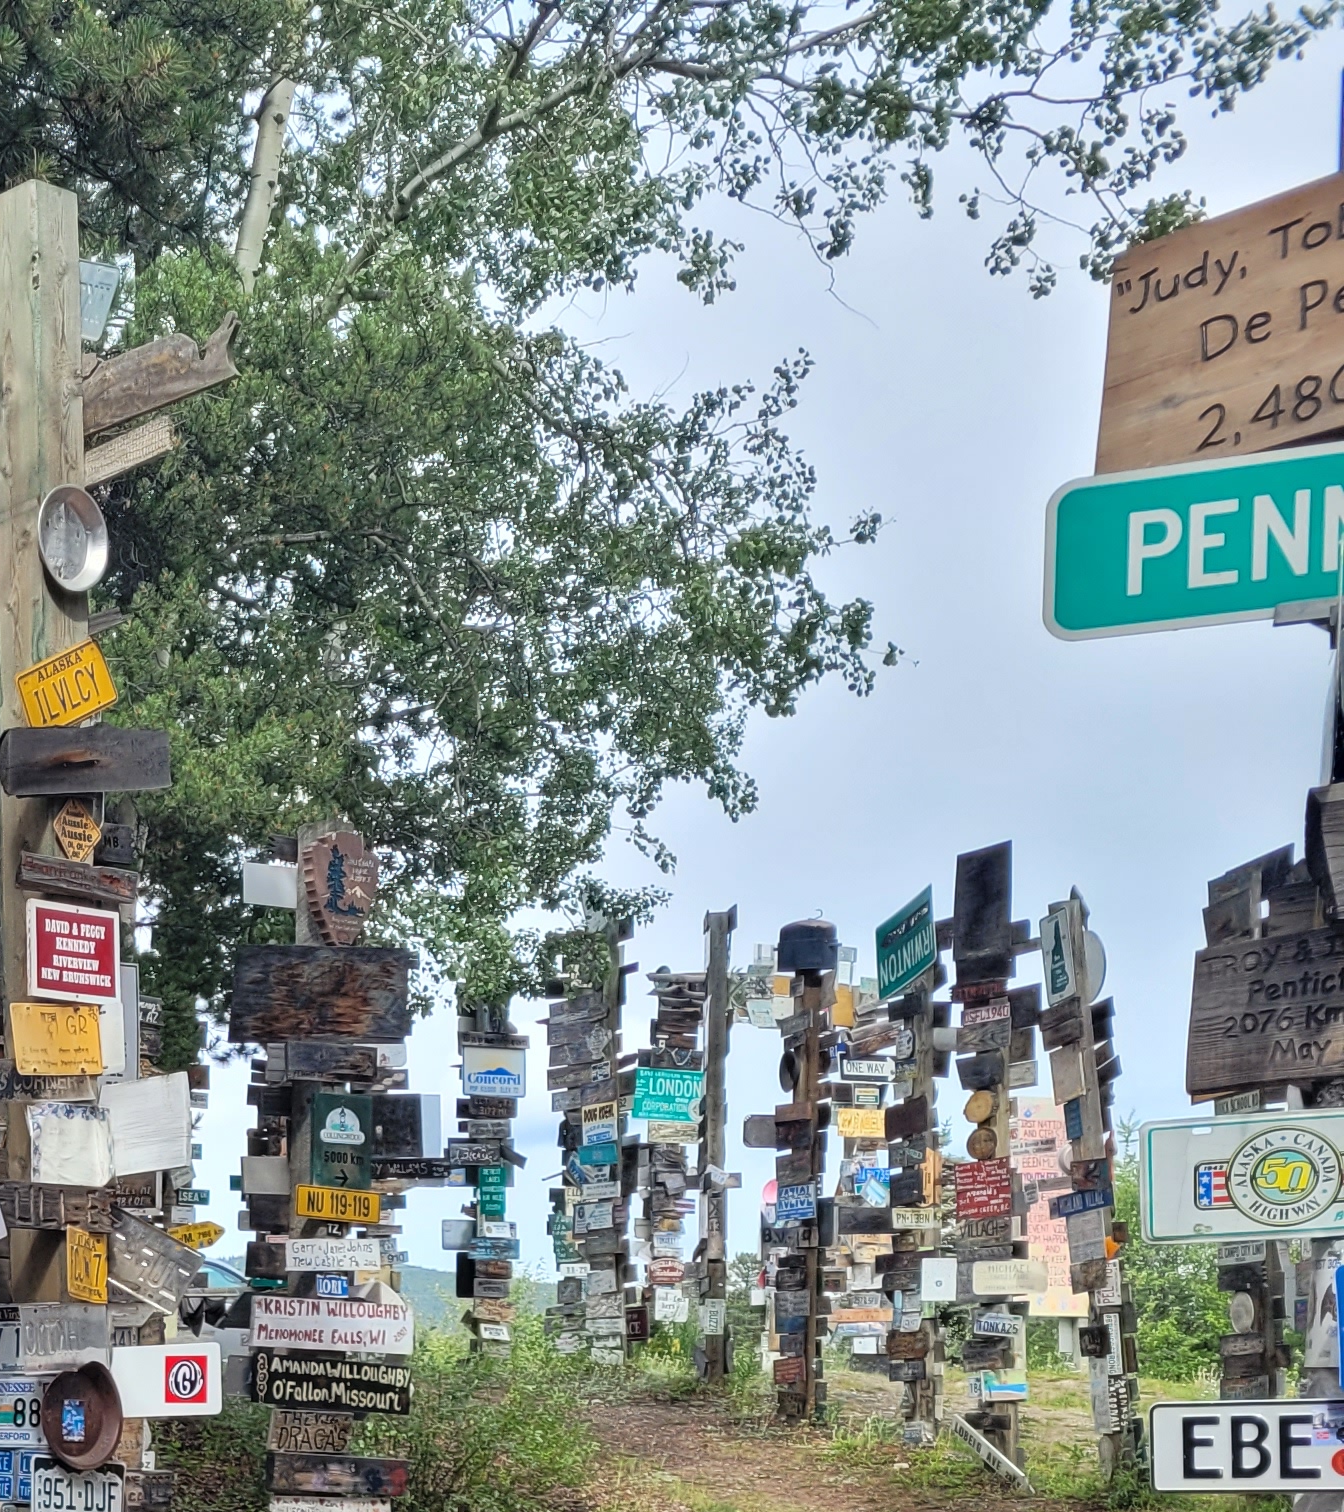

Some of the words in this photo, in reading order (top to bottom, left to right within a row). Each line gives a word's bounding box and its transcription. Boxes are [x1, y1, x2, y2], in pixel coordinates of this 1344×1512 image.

[1200, 312, 1272, 362] De
[45, 919, 66, 933] DAVID
[80, 923, 105, 939] PEGGY
[56, 937, 96, 953] KENNEDY
[54, 955, 100, 971] RIVERVIEW
[880, 924, 934, 985] IRWINTON
[63, 970, 111, 988] BRUNSWICK
[846, 1062, 863, 1074] ONE
[865, 1062, 885, 1074] WAY
[467, 1072, 520, 1086] Concord
[648, 1076, 701, 1098] LONDON
[1250, 1191, 1322, 1220] HIGHWAY
[265, 1301, 320, 1316] KRISTIN
[328, 1302, 408, 1319] WILLOUGHBY
[975, 1319, 1019, 1334] TONKA25
[41, 1476, 73, 1508] 951
